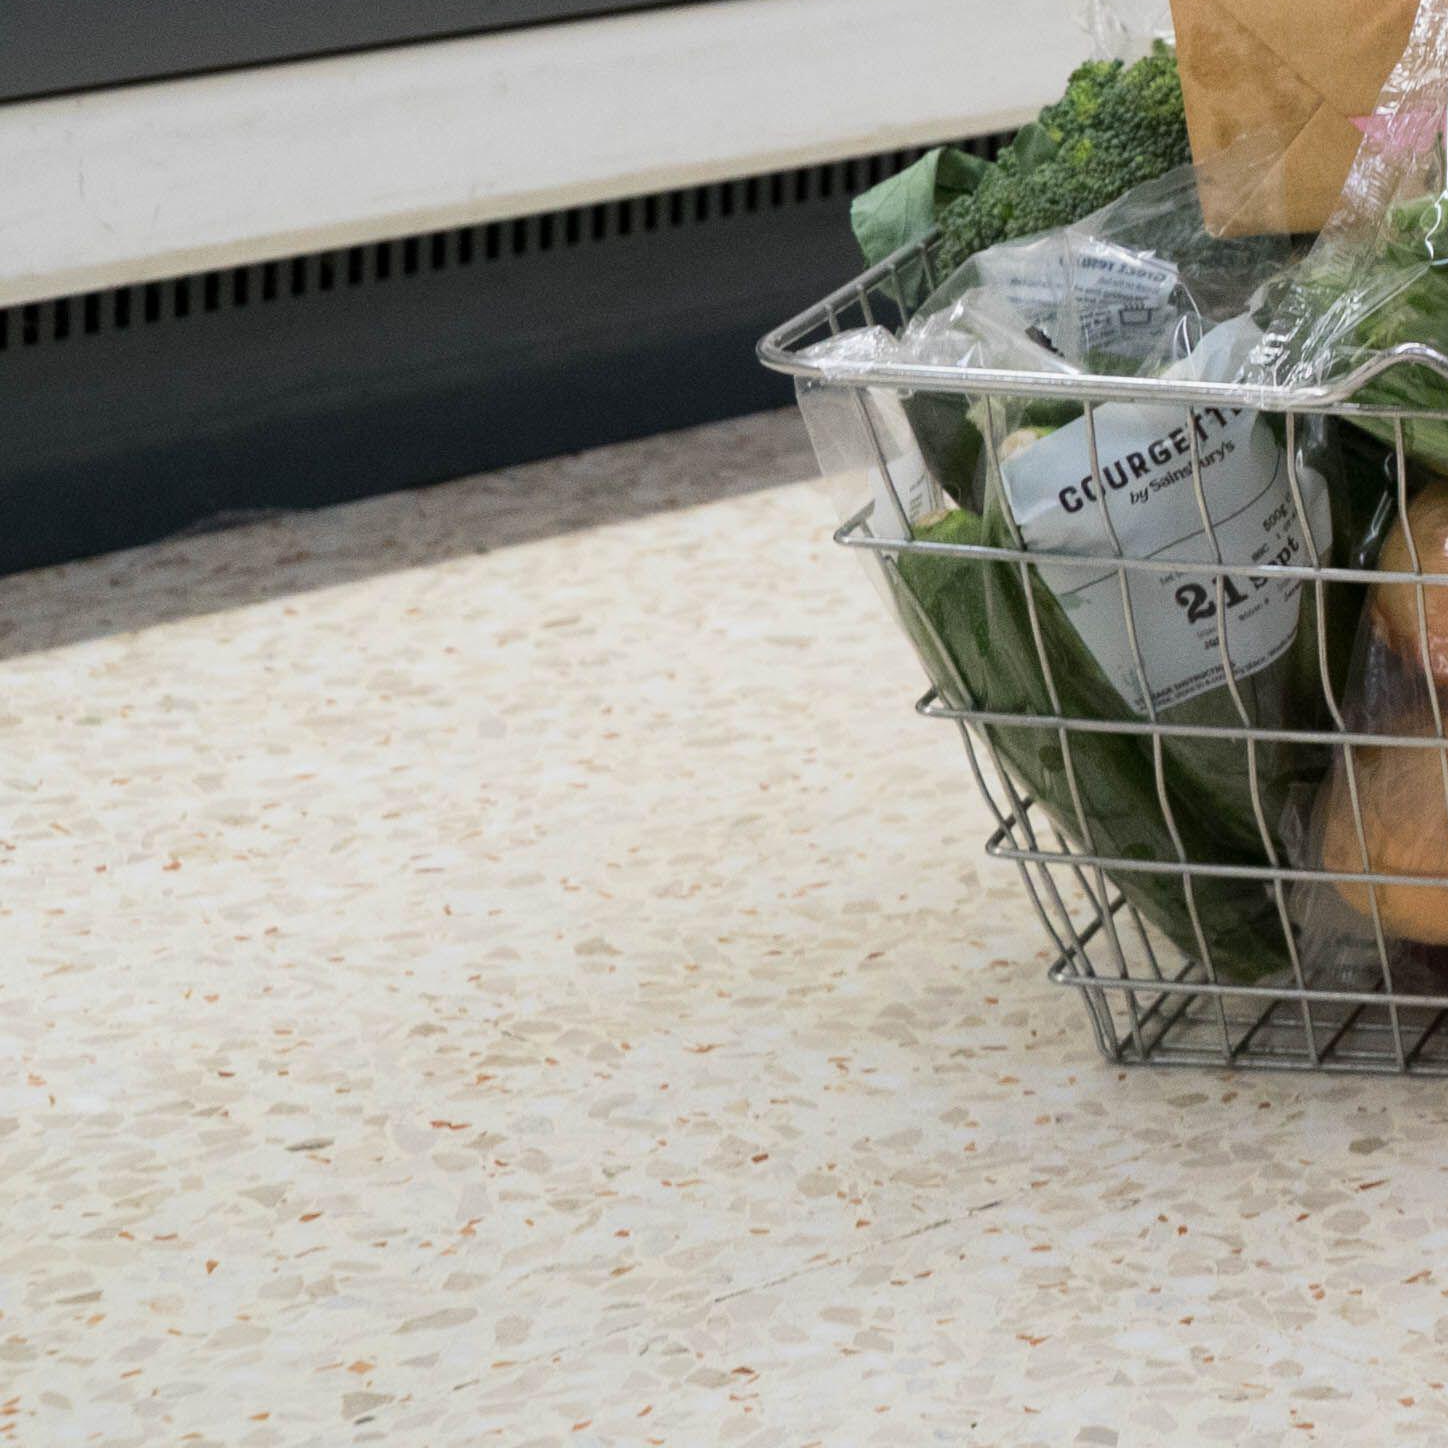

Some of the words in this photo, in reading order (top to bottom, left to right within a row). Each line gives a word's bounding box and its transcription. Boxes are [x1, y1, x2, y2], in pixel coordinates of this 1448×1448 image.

[1058, 406, 1243, 514] COURGETT
[1129, 488, 1150, 506] by
[1149, 438, 1236, 493] Sainsury's
[1174, 574, 1249, 625] 21
